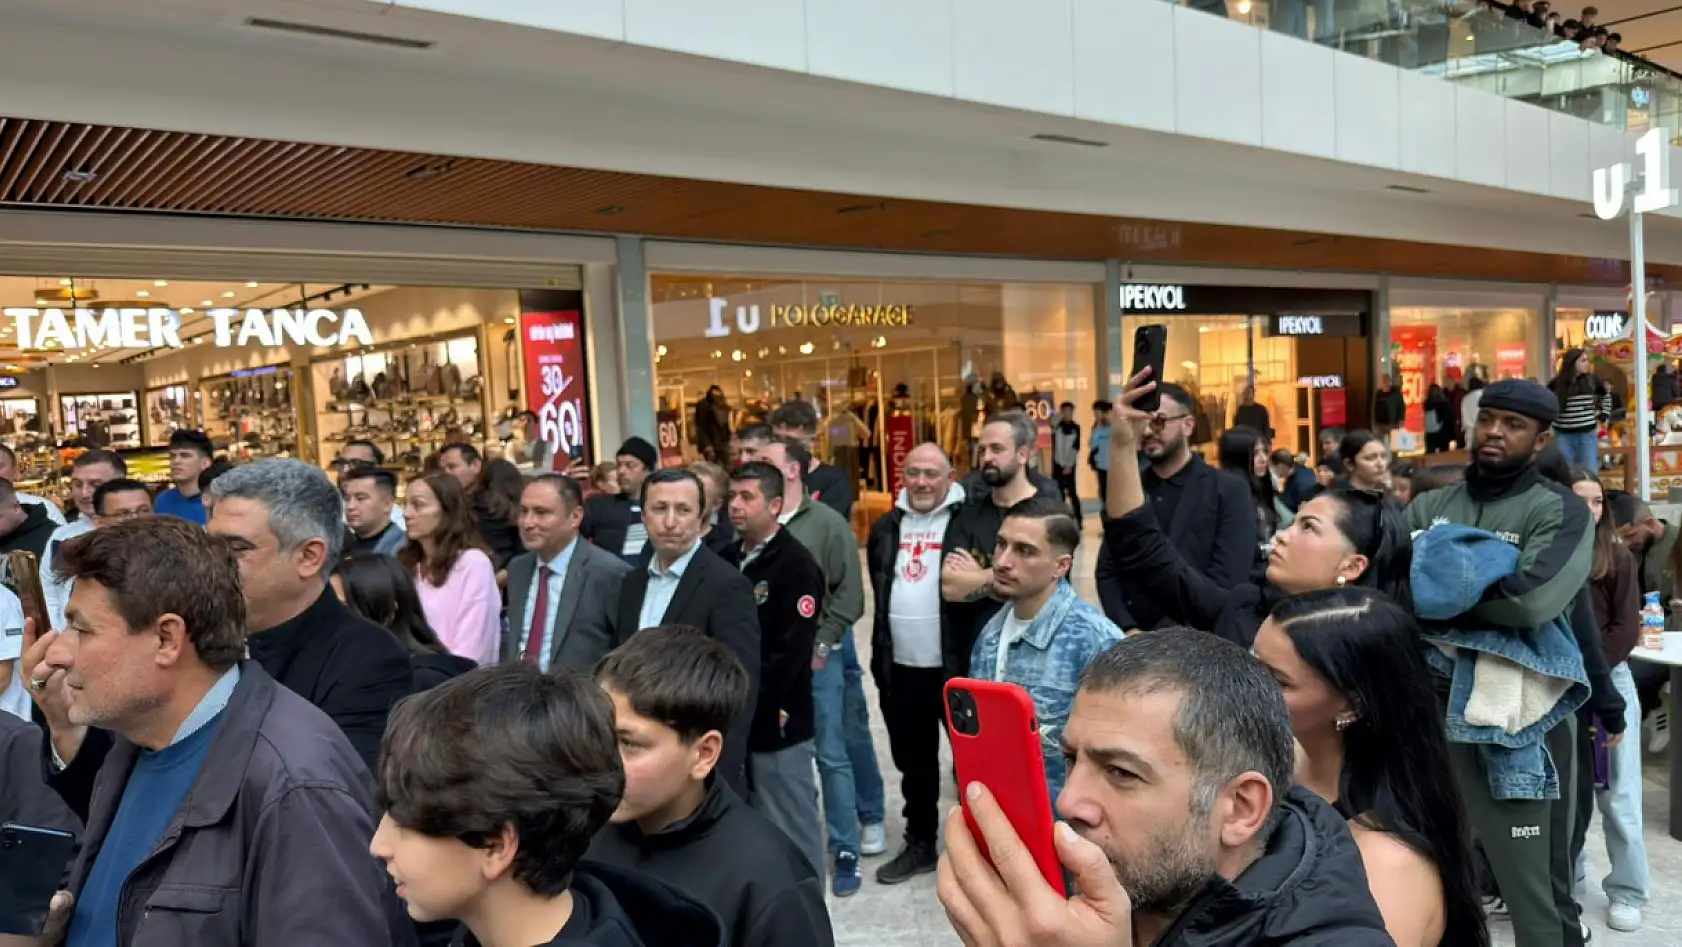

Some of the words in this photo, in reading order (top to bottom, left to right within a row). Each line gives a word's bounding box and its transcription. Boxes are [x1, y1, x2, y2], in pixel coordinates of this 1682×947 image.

[3, 308, 181, 349] TAMER
[207, 308, 374, 347] TANCA
[1025, 400, 1049, 420] 60
[540, 402, 578, 454] 60
[659, 422, 677, 448] 60
